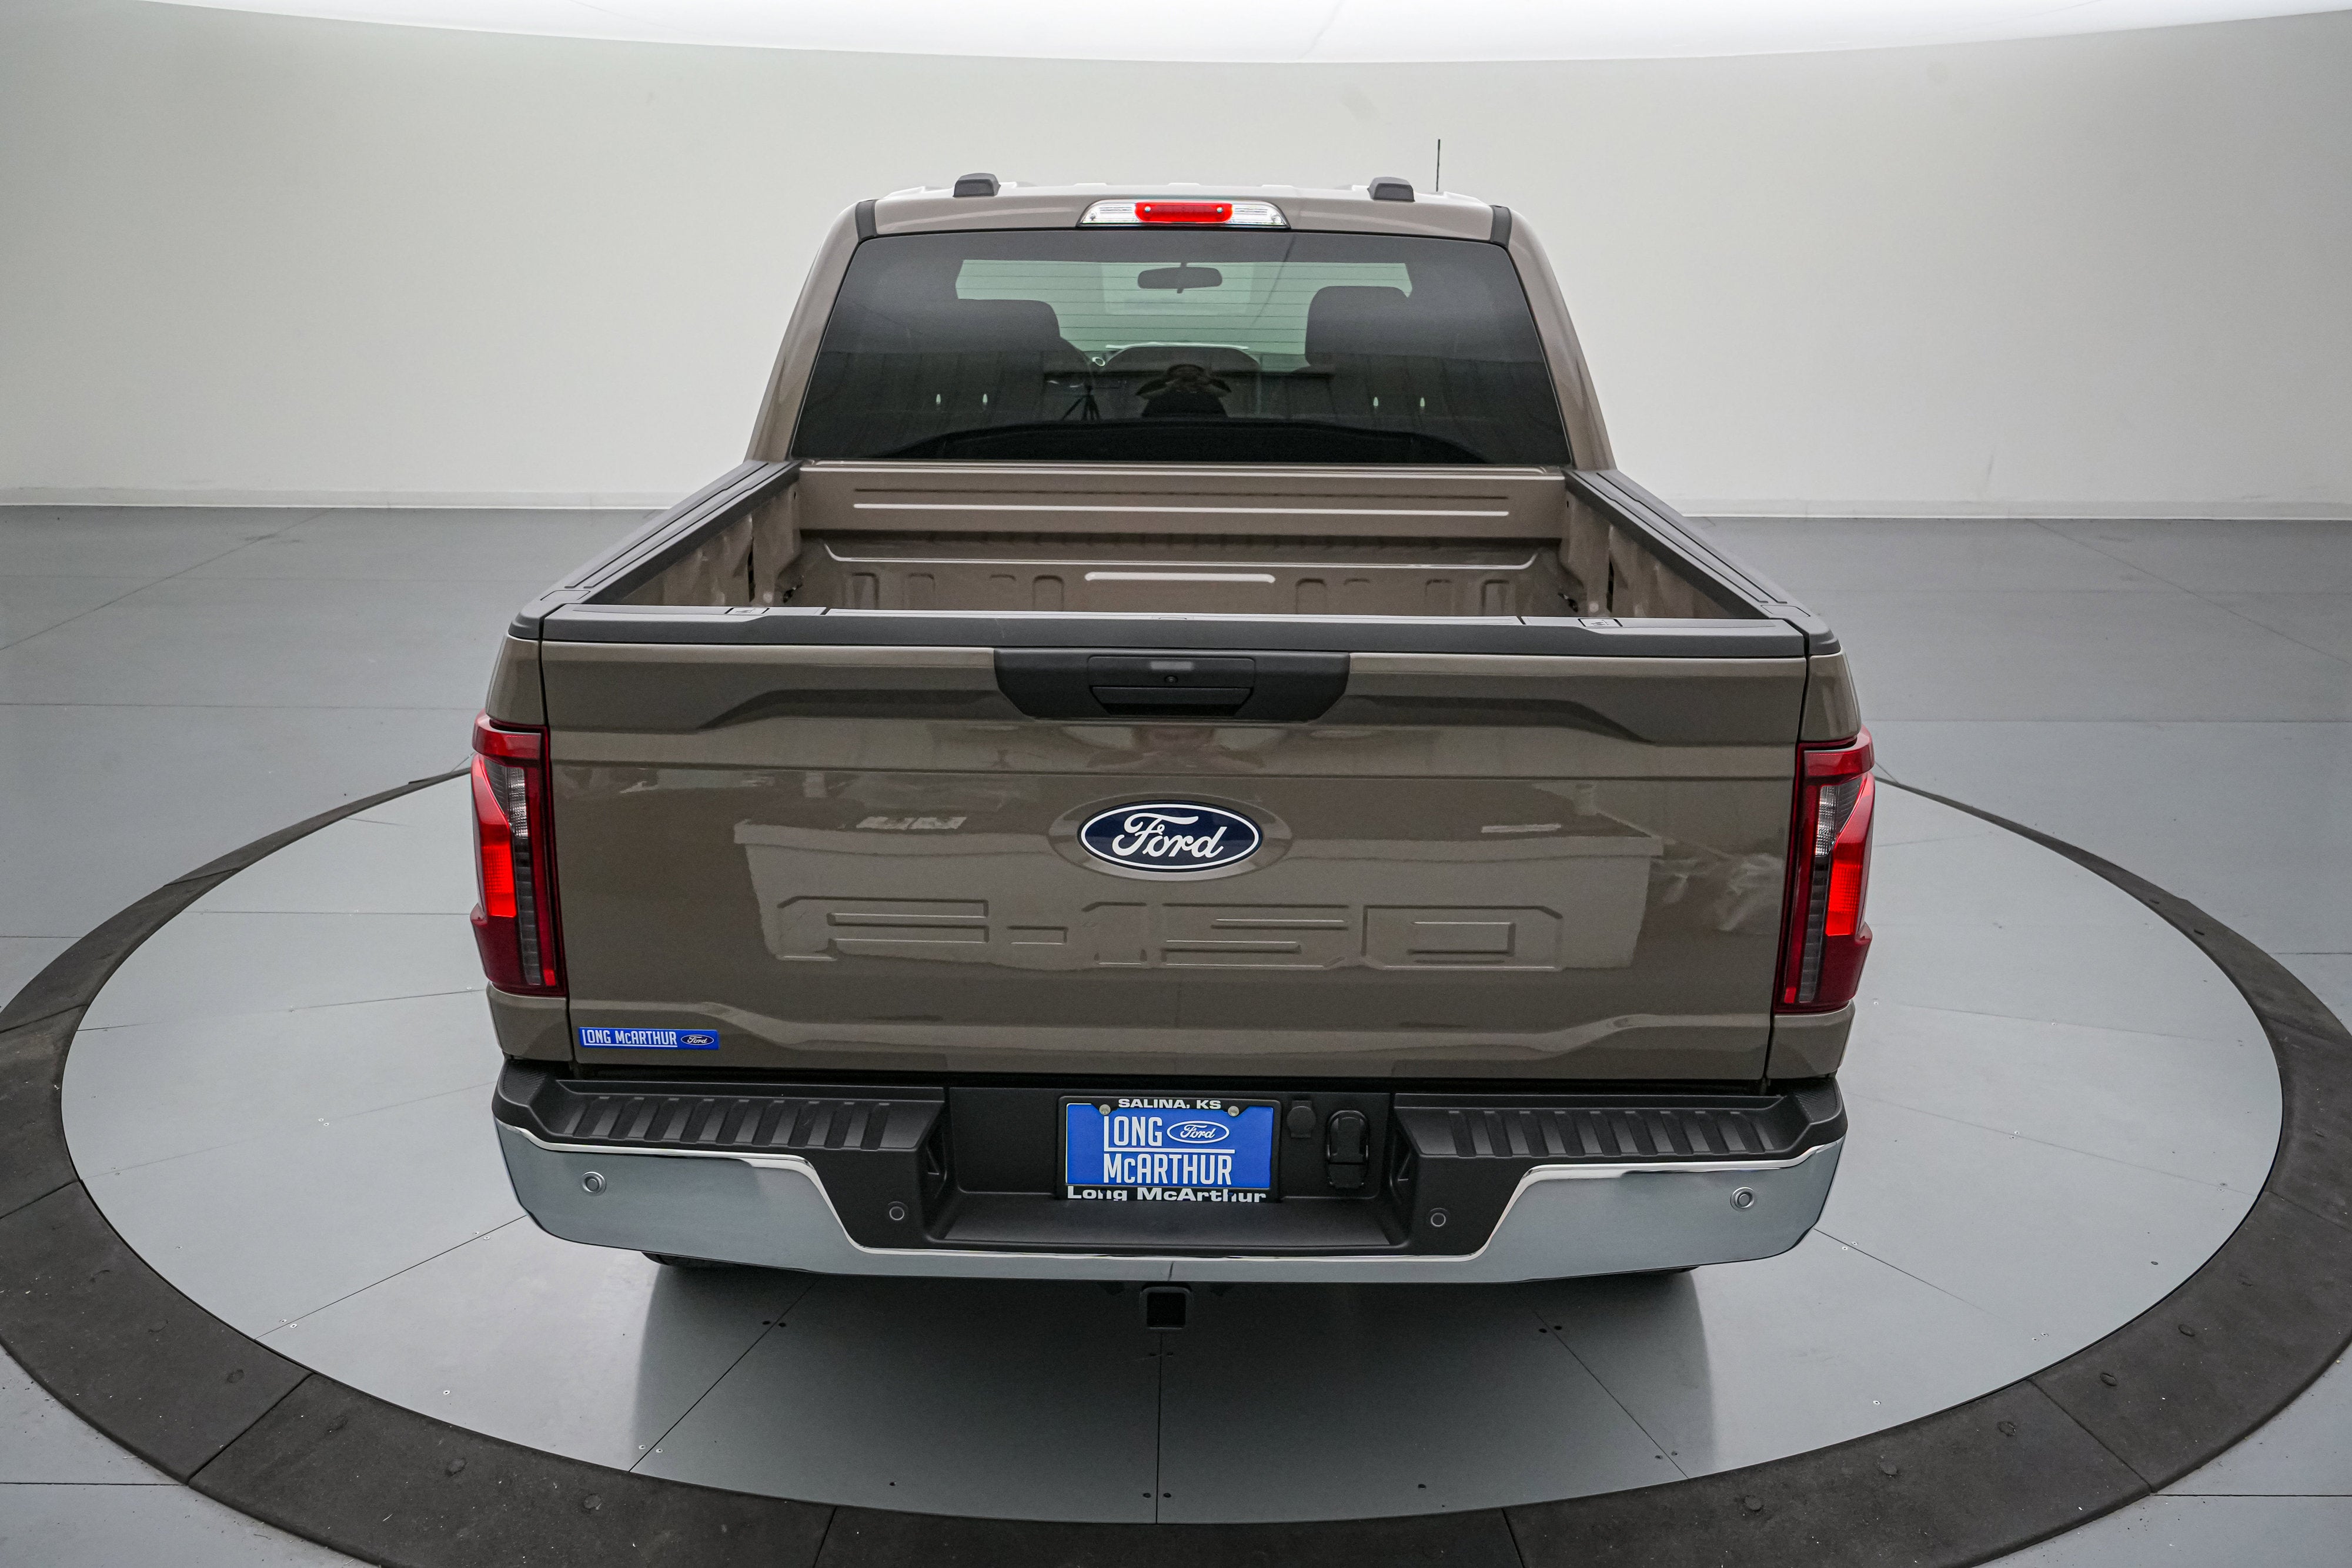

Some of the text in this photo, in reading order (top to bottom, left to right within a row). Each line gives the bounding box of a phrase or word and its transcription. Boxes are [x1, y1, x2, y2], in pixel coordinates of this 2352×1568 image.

[1111, 813, 1228, 858] Ford
[582, 1029, 677, 1046] LONG McARTHUR
[687, 1035, 708, 1045] Ford
[1118, 1098, 1222, 1110] SALINA, KS
[1104, 1116, 1162, 1151] LONG
[1180, 1122, 1216, 1140] Ford
[1103, 1153, 1232, 1185] McARTHUR
